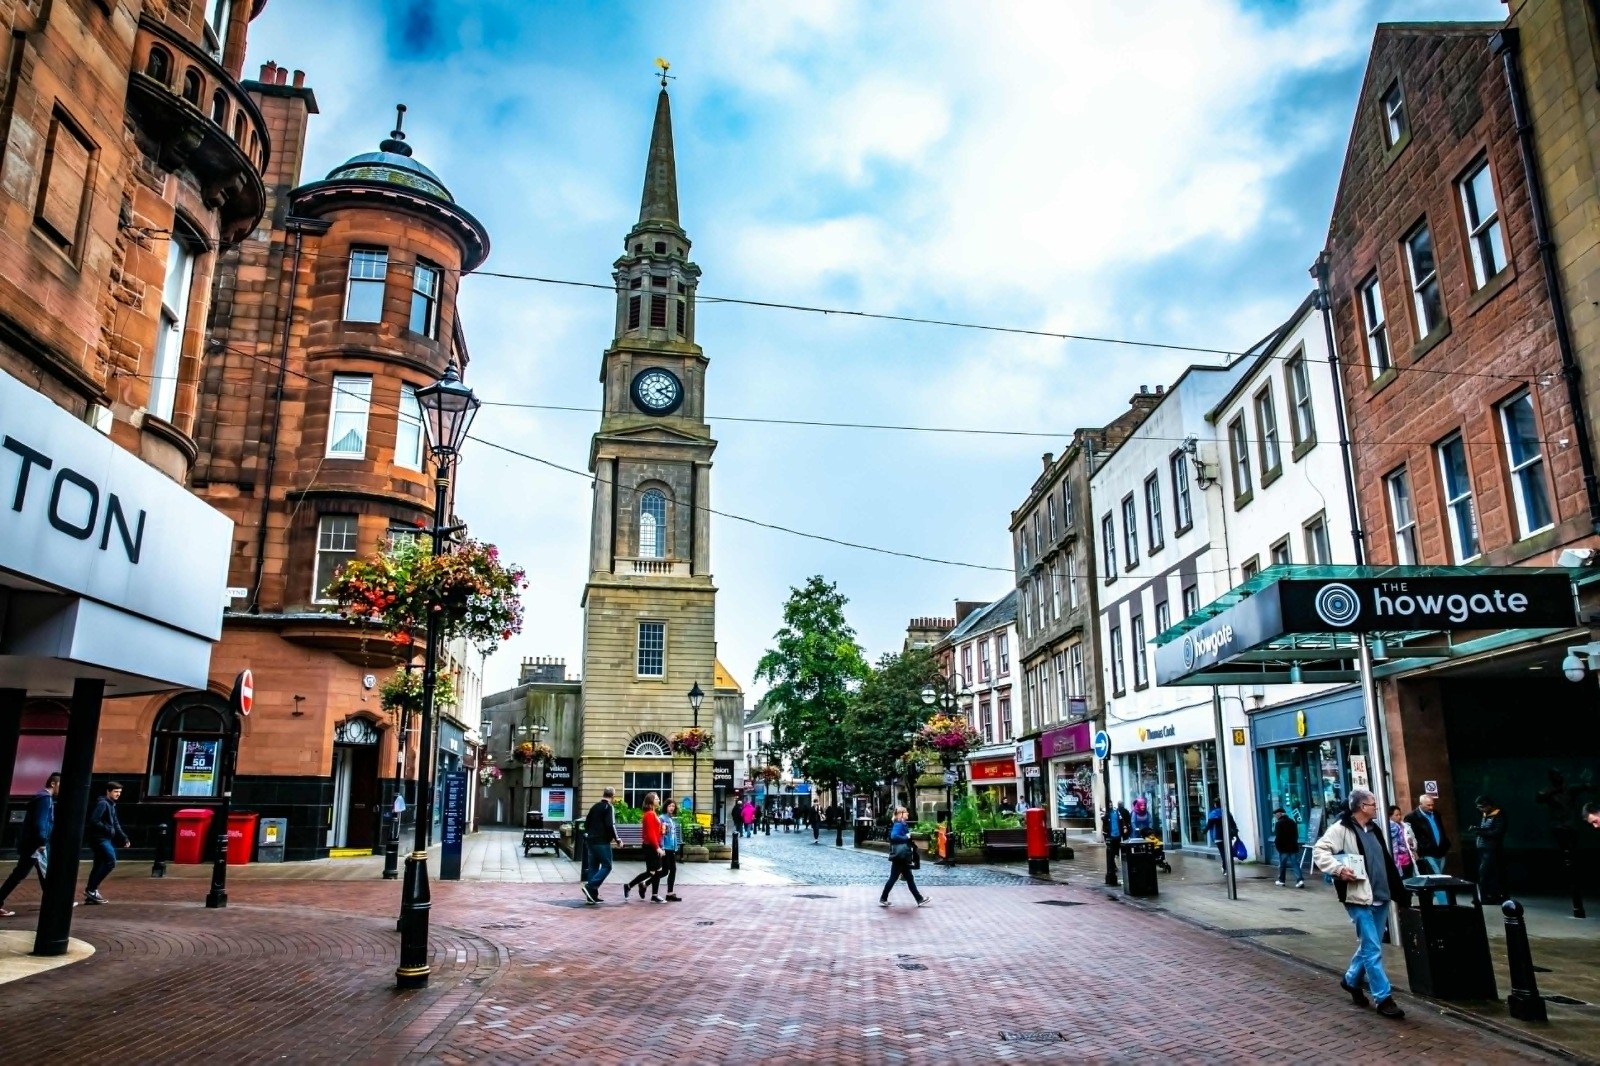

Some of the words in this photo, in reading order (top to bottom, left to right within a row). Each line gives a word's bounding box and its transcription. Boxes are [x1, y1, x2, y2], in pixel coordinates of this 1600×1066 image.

[2, 434, 146, 564] TON
[1382, 583, 1408, 592] THE
[1373, 587, 1529, 623] howgate
[1194, 624, 1233, 657] howgate
[1146, 728, 1164, 740] Thomas
[1163, 723, 1176, 738] Cook
[192, 758, 206, 767] 50
[1353, 761, 1365, 773] SALE
